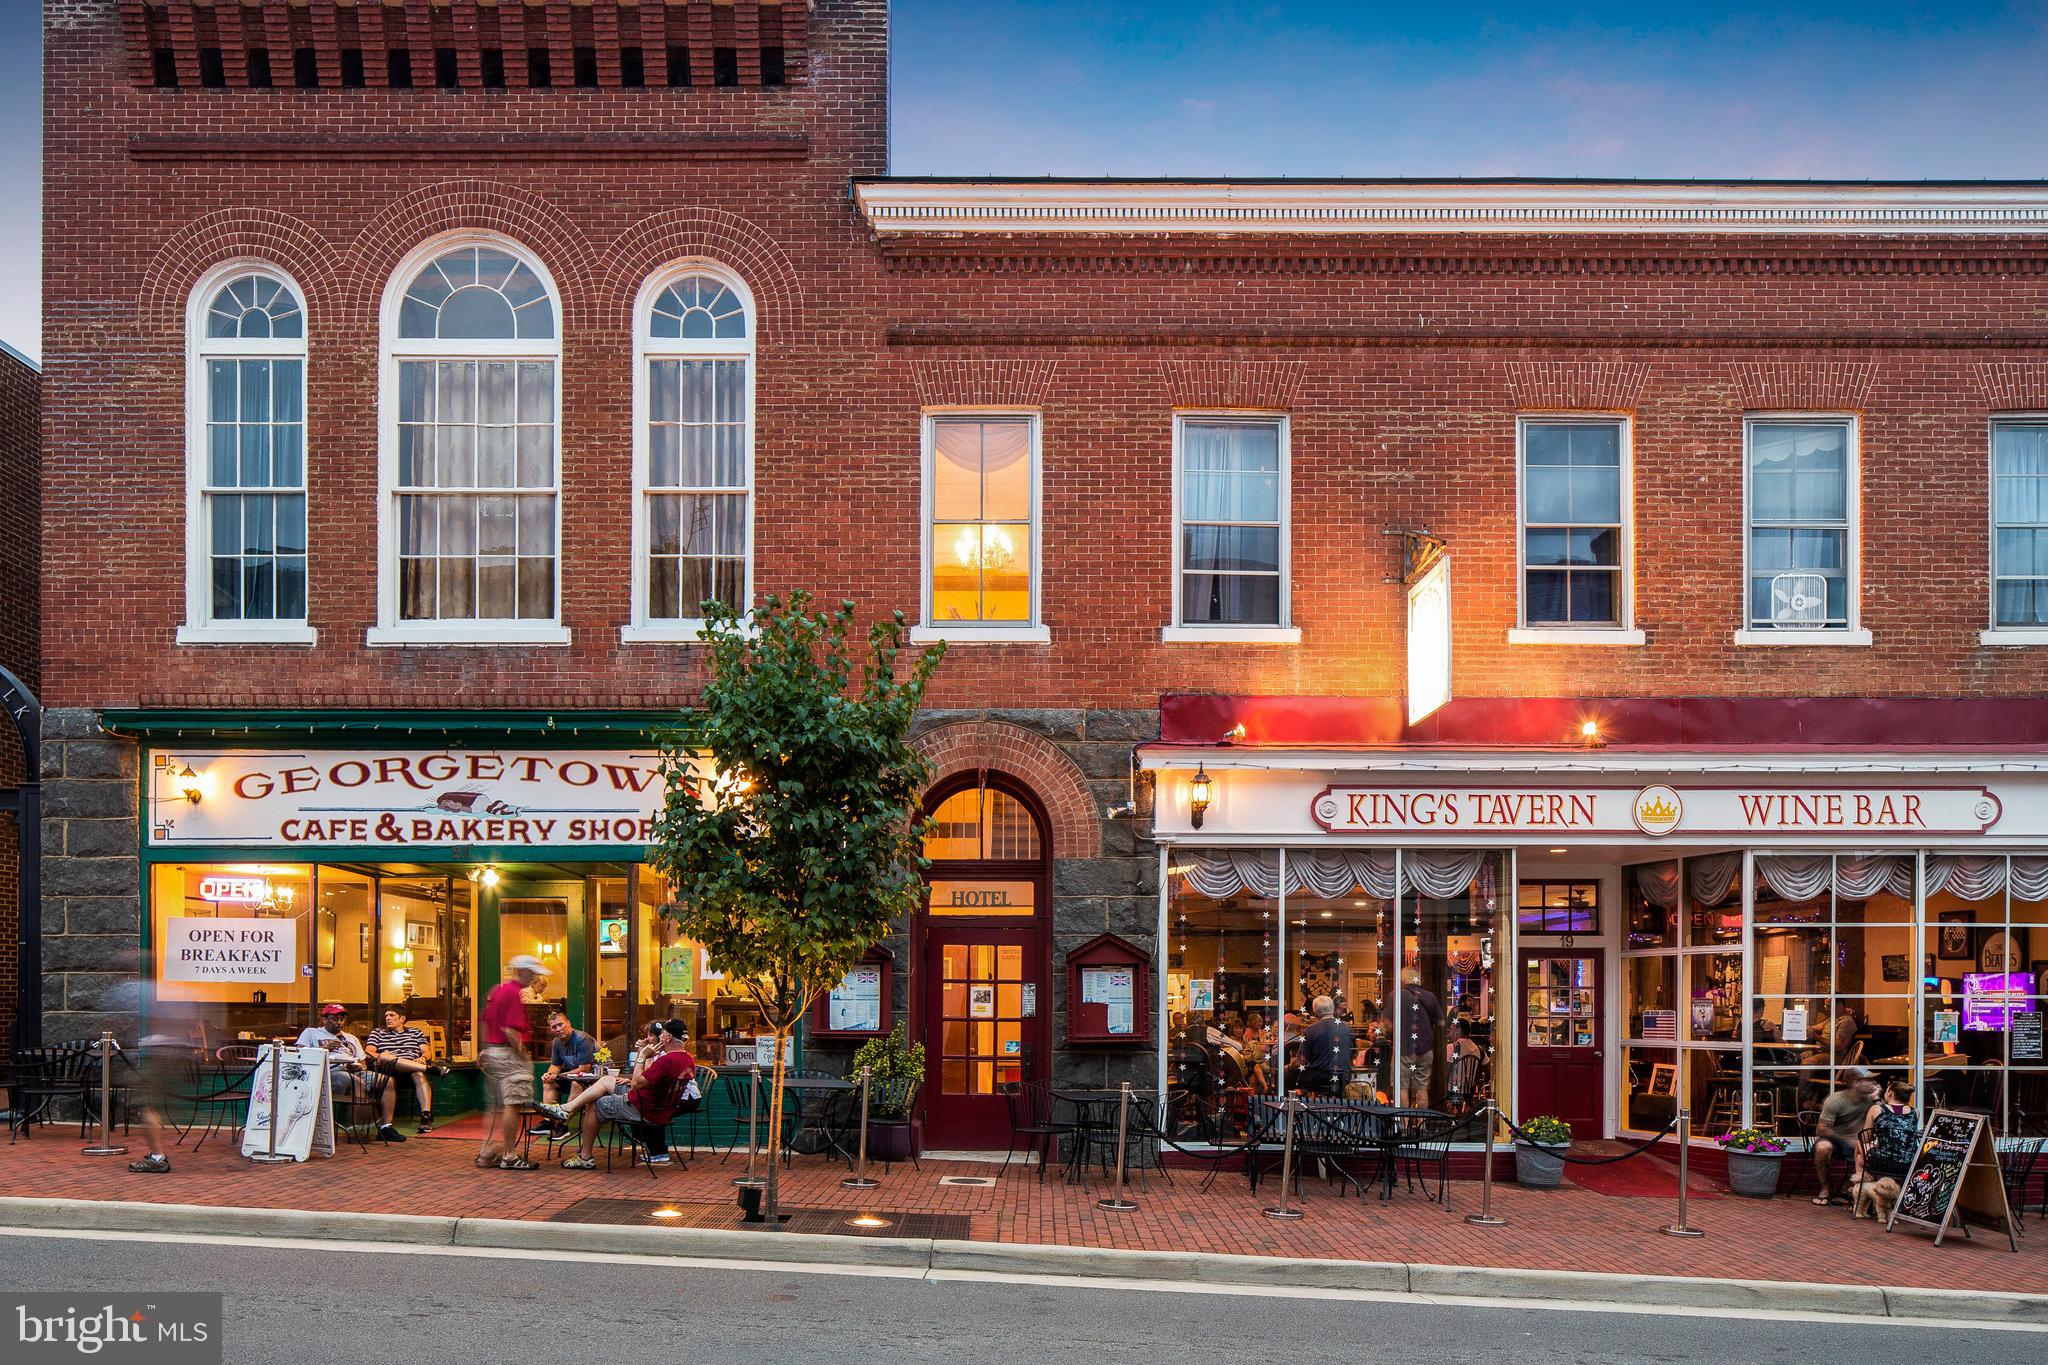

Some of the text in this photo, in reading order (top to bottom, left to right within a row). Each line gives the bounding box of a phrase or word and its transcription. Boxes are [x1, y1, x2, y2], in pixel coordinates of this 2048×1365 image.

[233, 753, 701, 801] GEORGETOW
[1347, 793, 1597, 828] KING'S TAVERN
[1738, 794, 1928, 829] WINE BAR
[200, 880, 265, 899] OPEN
[951, 890, 1012, 907] HOTEL
[189, 929, 275, 943] OPEN FOR
[1559, 936, 1574, 948] 19
[181, 949, 282, 963] BREAKFAST
[1984, 949, 2018, 970] BEATS
[194, 966, 267, 975] 7 DAYS A WEEK
[728, 1048, 754, 1063] Open
